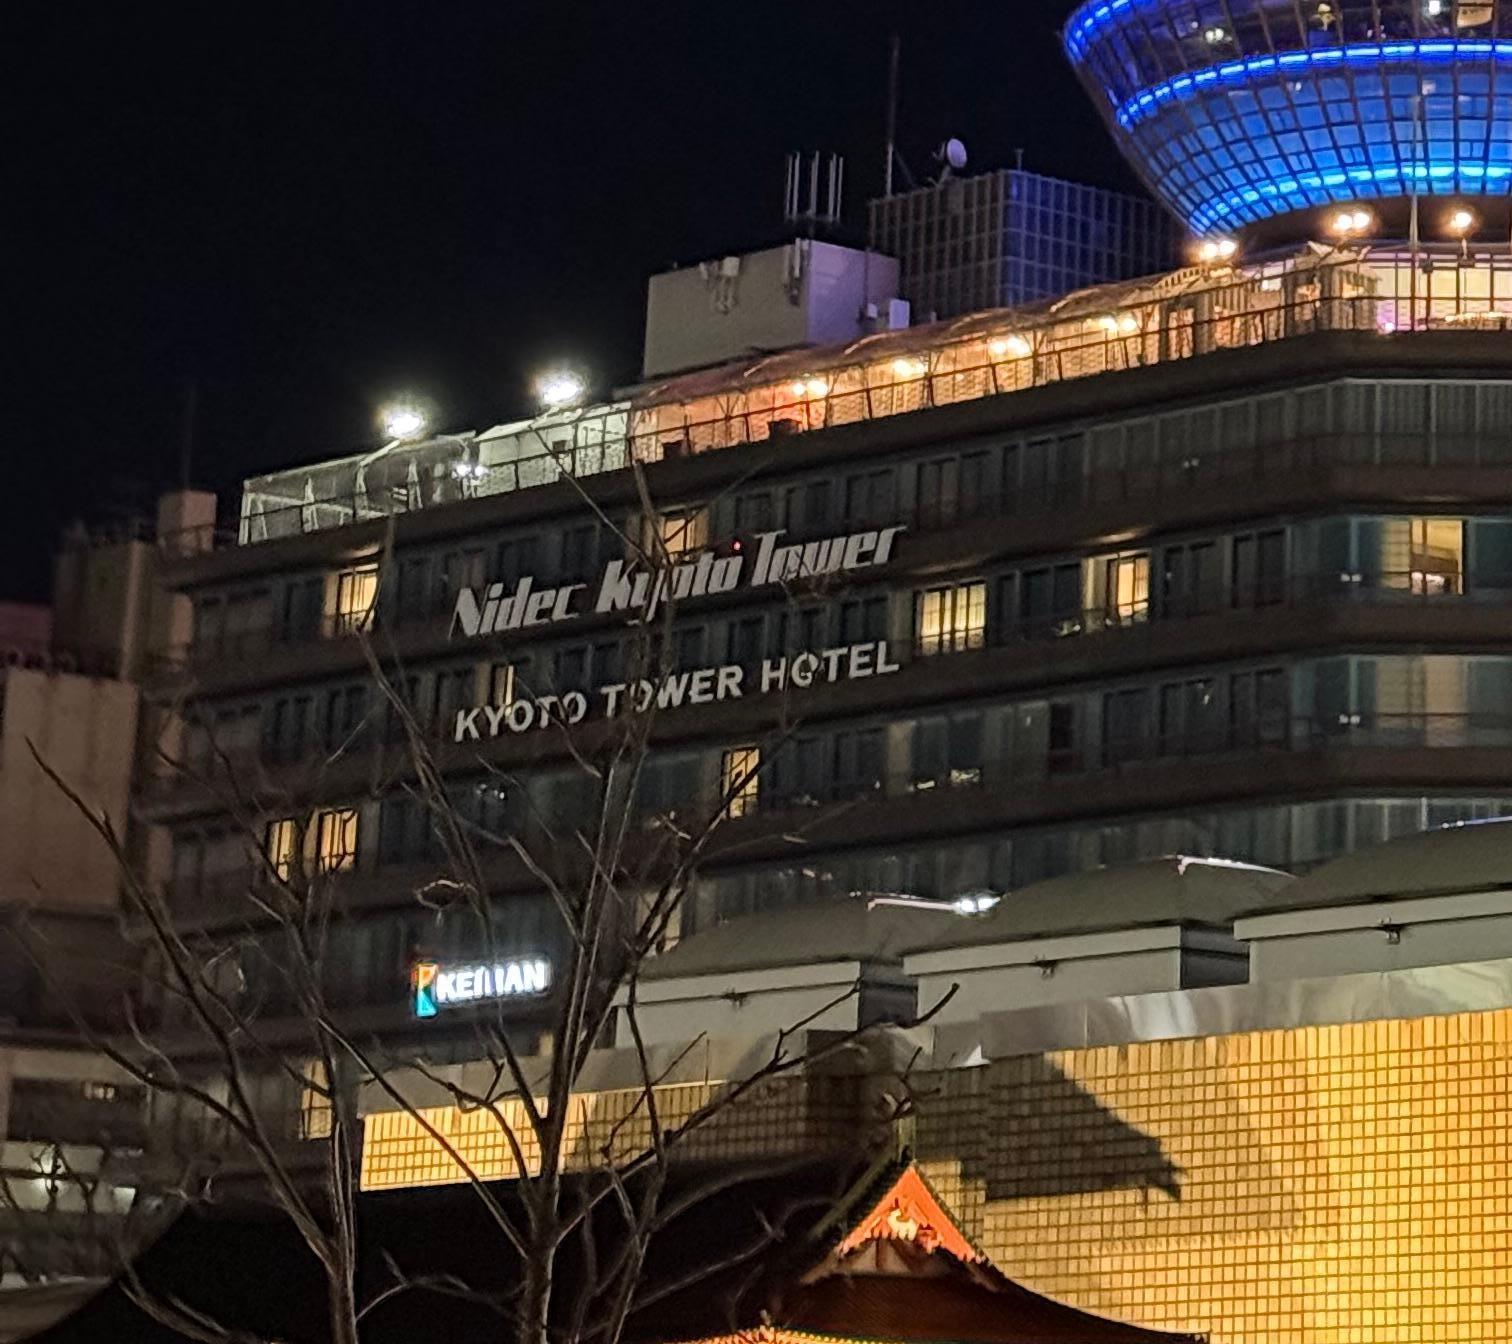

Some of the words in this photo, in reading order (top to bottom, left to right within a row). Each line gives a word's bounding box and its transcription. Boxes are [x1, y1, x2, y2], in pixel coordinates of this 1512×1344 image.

[448, 576, 588, 640] Nidec
[595, 550, 744, 626] Kyoto
[750, 526, 907, 587] Tower
[454, 691, 588, 743] KYOTO
[600, 665, 744, 716] TOWER
[760, 640, 900, 694] HOTEL
